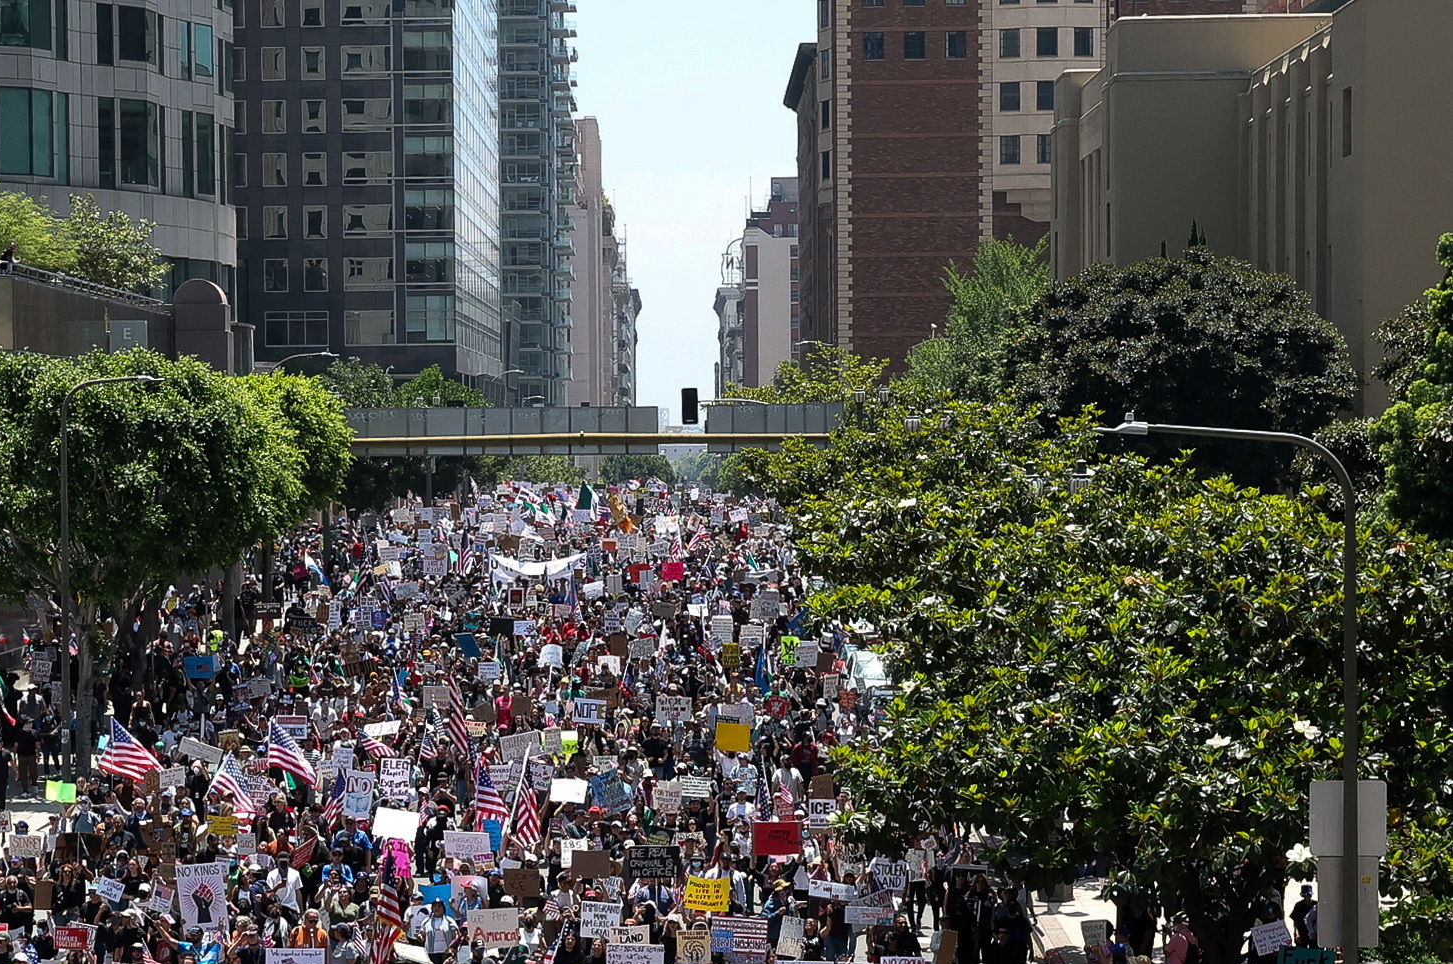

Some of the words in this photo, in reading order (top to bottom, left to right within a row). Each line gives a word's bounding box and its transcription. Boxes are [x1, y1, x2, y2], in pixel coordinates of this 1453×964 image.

[630, 849, 645, 858] THE
[648, 848, 671, 858] REAL
[666, 859, 673, 867] IS
[177, 868, 191, 877] NO
[194, 864, 221, 876] KINGS
[642, 865, 677, 877] OFFICE!
[875, 864, 906, 877] STOLEN
[875, 875, 902, 889] LAND
[620, 933, 643, 943] LAND
